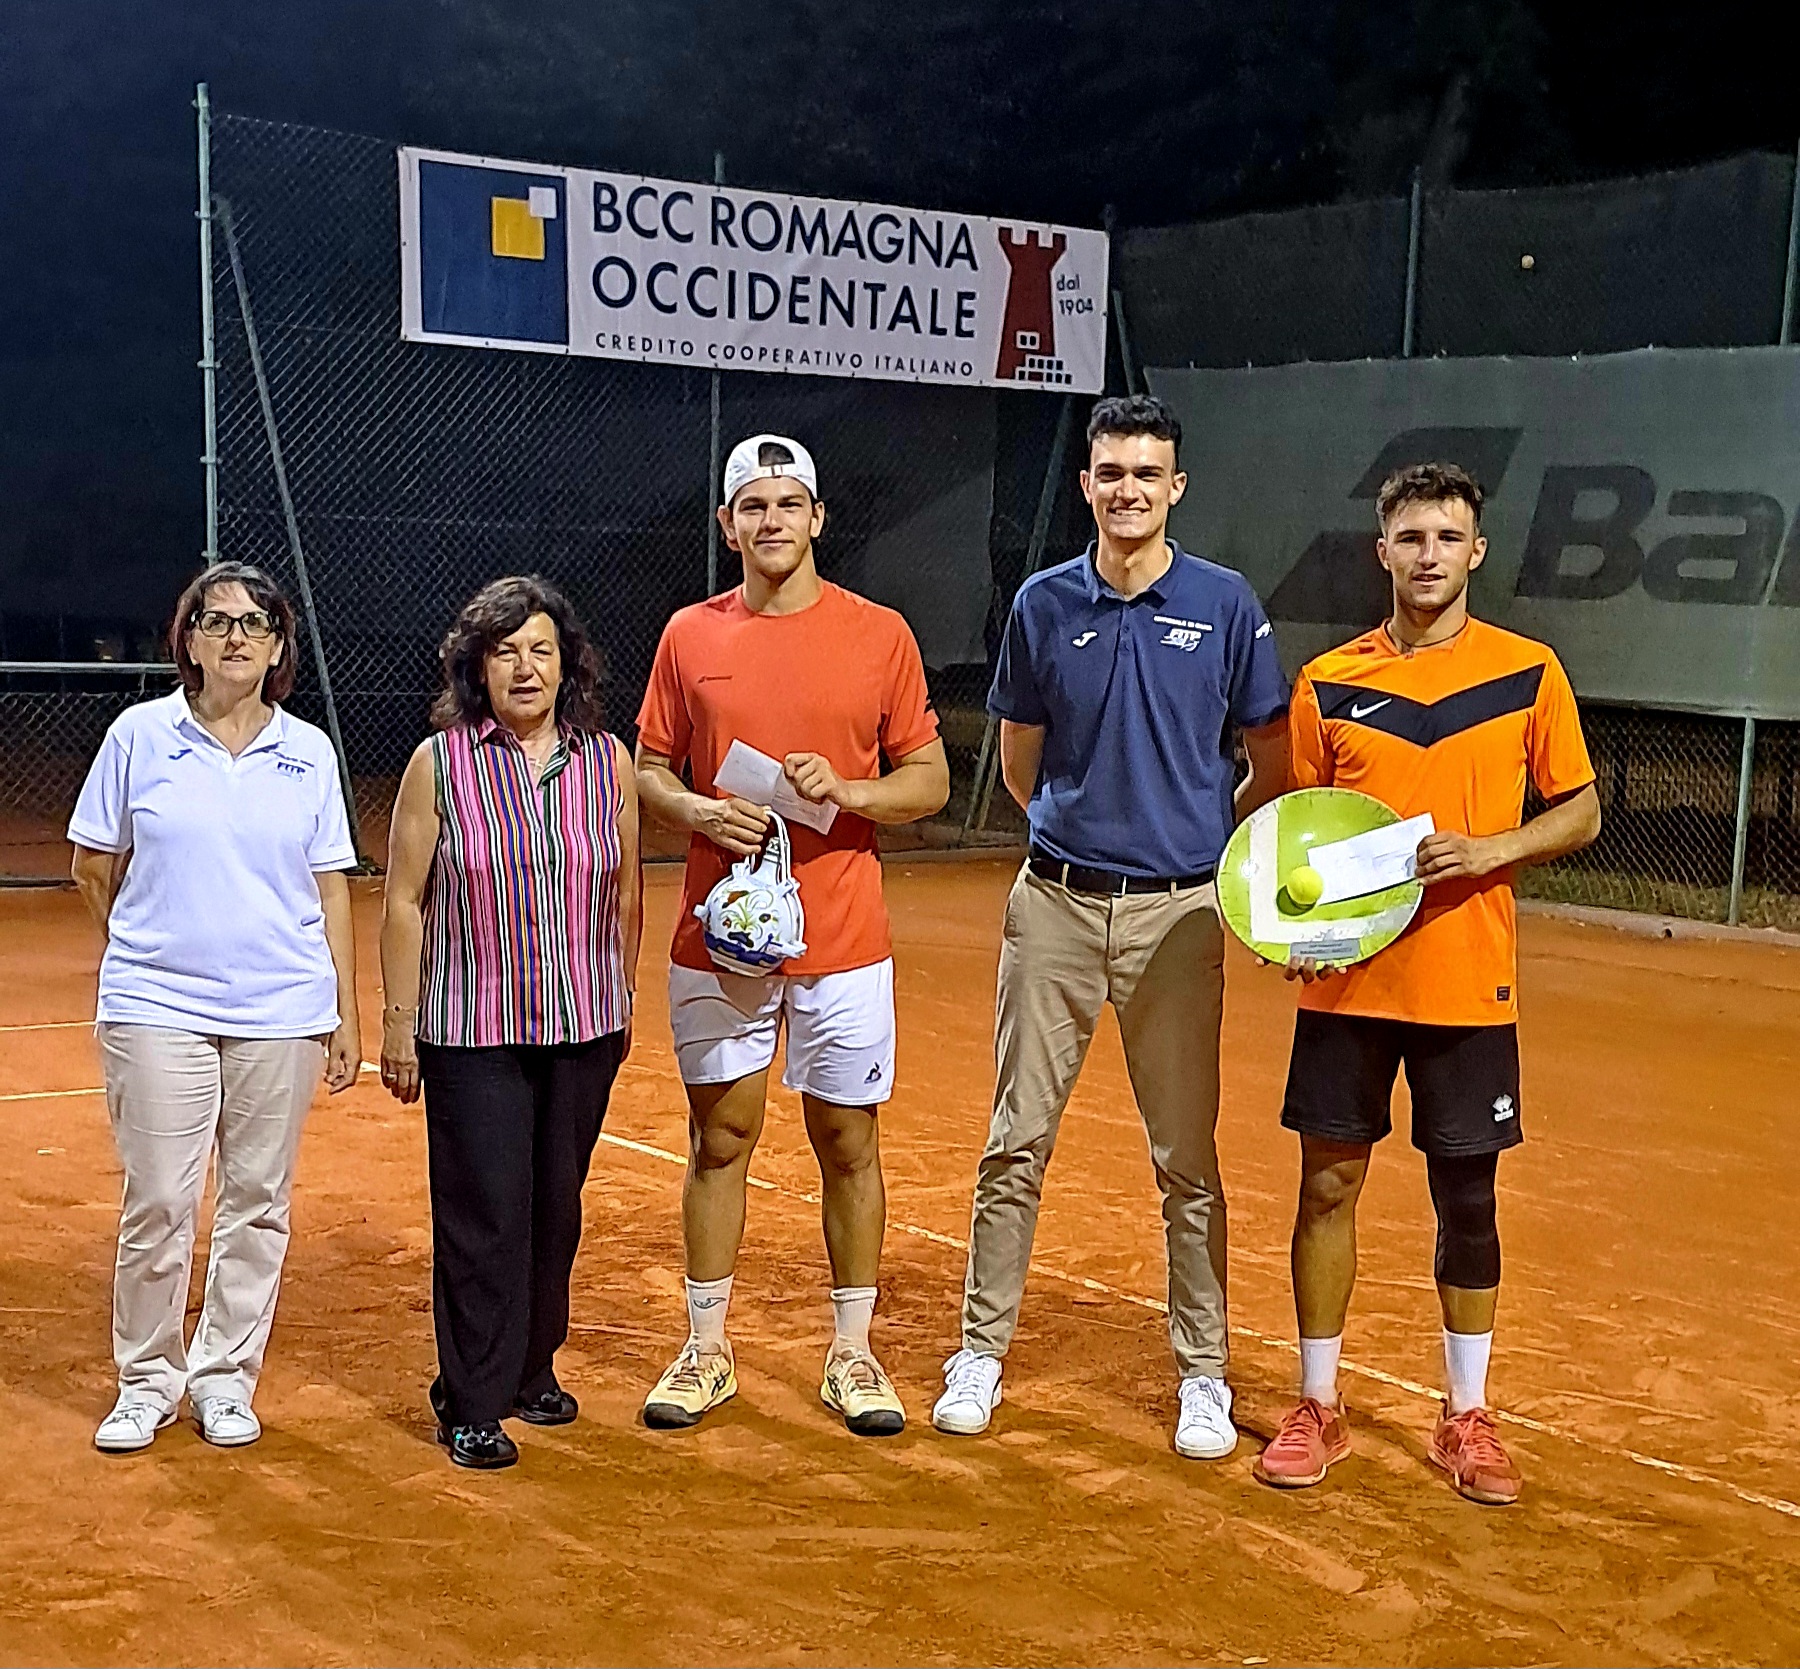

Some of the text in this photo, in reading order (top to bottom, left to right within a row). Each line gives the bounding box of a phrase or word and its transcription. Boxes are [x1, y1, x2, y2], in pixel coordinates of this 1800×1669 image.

[593, 180, 978, 272] BCC ROMAGNA
[592, 255, 976, 339] OCCIDENTALE
[1056, 274, 1080, 291] dal
[1060, 298, 1093, 316] 1904
[595, 332, 973, 378] CREDITO COOPERATIVO ITALIANO
[1514, 464, 1800, 607] Ba
